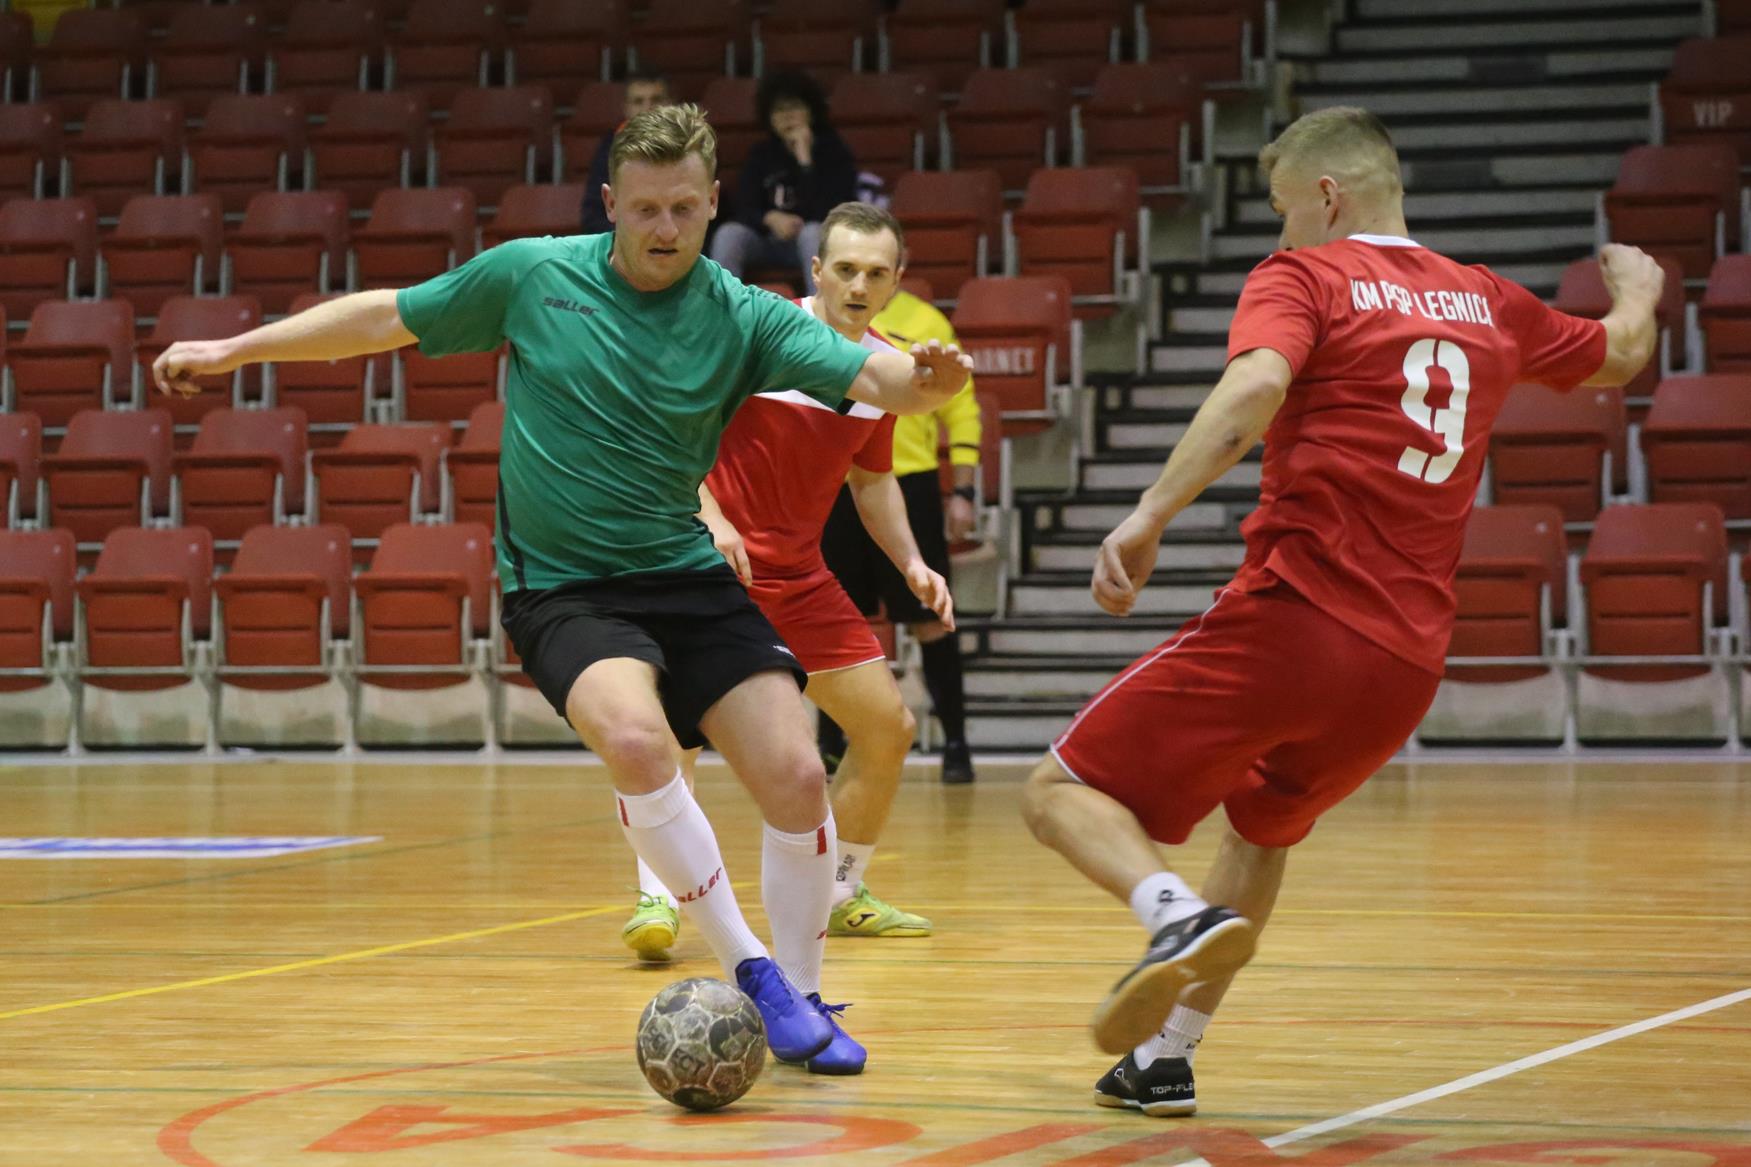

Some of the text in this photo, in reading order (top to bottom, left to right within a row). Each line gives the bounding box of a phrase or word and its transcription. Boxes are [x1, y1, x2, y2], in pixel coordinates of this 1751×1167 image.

[1694, 102, 1733, 127] VIP
[1350, 279, 1383, 311] KM
[1379, 280, 1413, 316] PSP
[1397, 338, 1470, 484] 9
